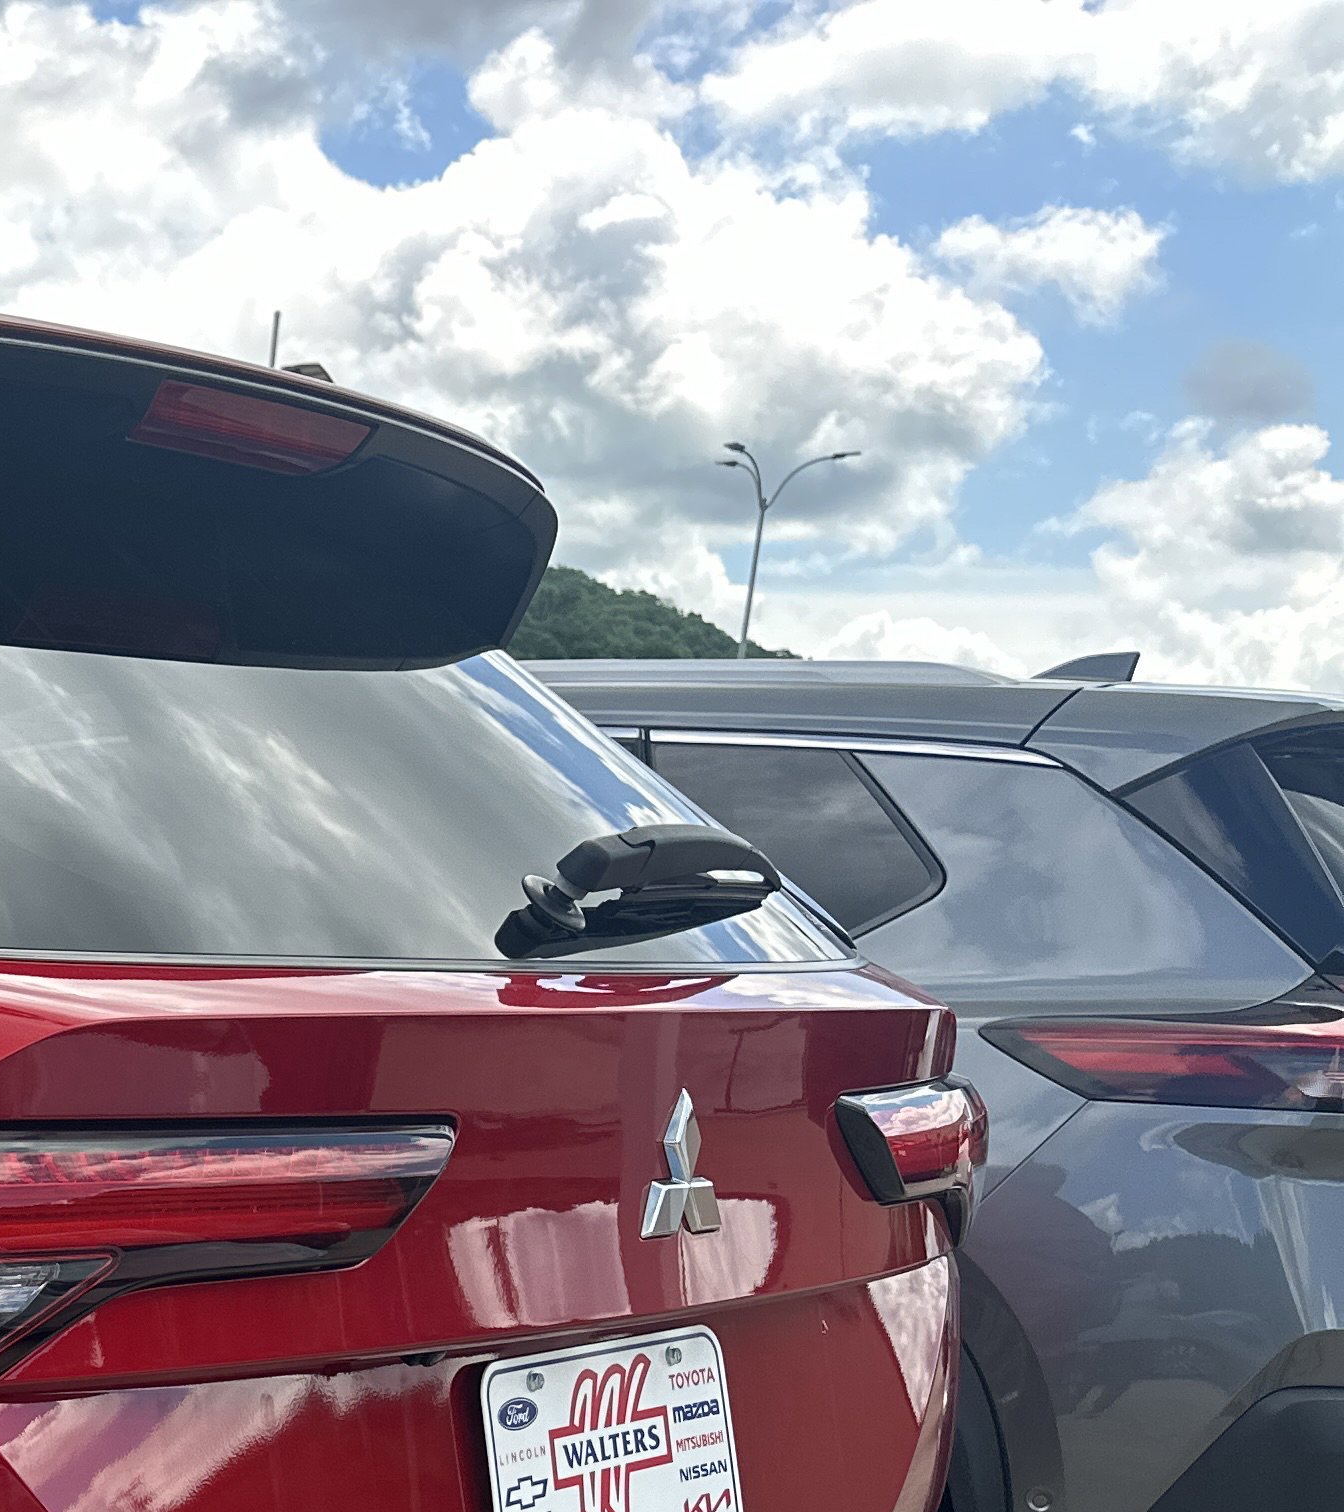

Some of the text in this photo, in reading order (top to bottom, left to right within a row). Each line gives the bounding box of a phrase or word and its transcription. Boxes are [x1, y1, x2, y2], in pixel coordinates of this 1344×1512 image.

[668, 1367, 715, 1391] TOYOTA
[563, 1424, 660, 1469] WALTERS
[675, 1430, 724, 1452] MITSUBISHI
[499, 1445, 547, 1467] LINCOLN
[679, 1459, 728, 1483] NISSAN
